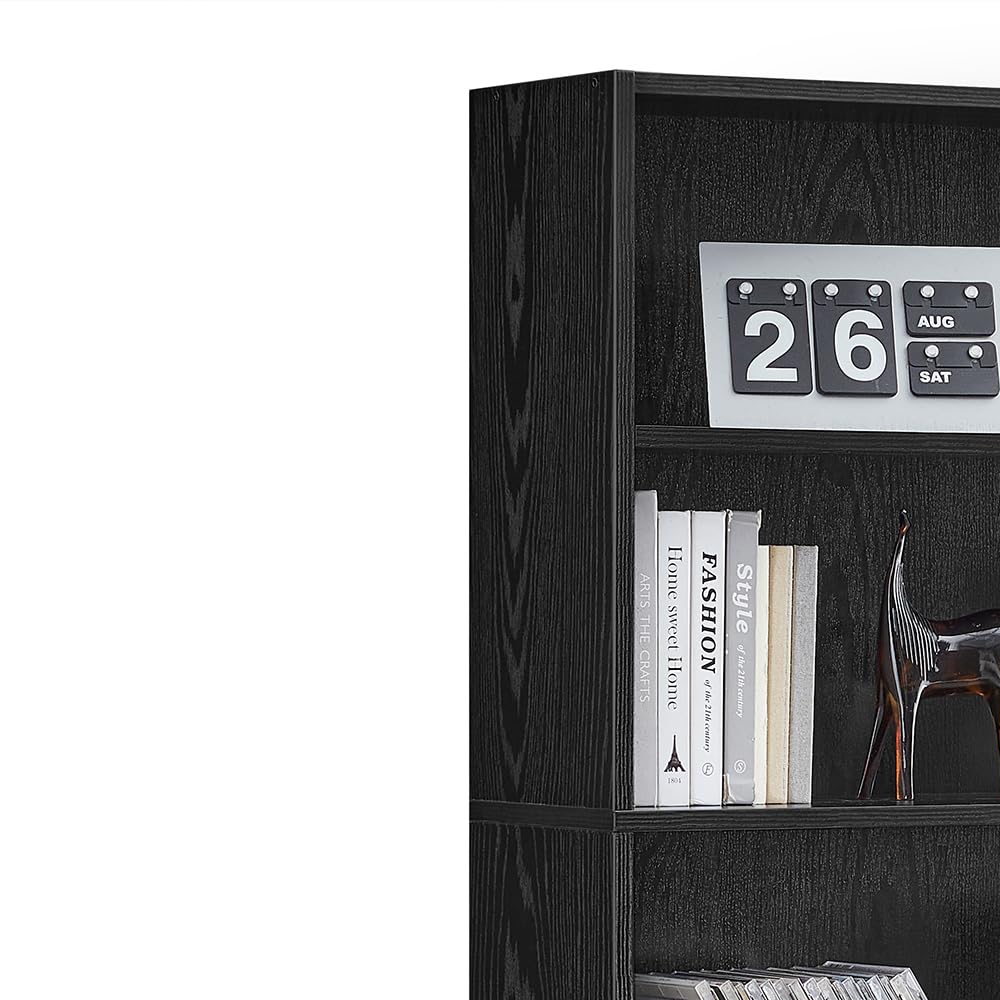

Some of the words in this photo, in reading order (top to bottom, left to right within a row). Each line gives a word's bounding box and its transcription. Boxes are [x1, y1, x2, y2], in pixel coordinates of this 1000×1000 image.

[917, 315, 955, 329] AUG
[919, 370, 952, 384] SAT
[668, 547, 683, 600] Home
[639, 572, 651, 609] ARTS
[732, 563, 753, 634] Style
[668, 605, 680, 651] sweet
[701, 552, 717, 674] FASHION
[639, 614, 651, 644] THE
[736, 644, 746, 655] of
[737, 656, 746, 669] the
[639, 650, 651, 703] CRAFTS
[668, 657, 683, 710] Home
[703, 679, 712, 690] of
[704, 690, 712, 703] the
[735, 688, 744, 719] century
[703, 722, 711, 753] century
